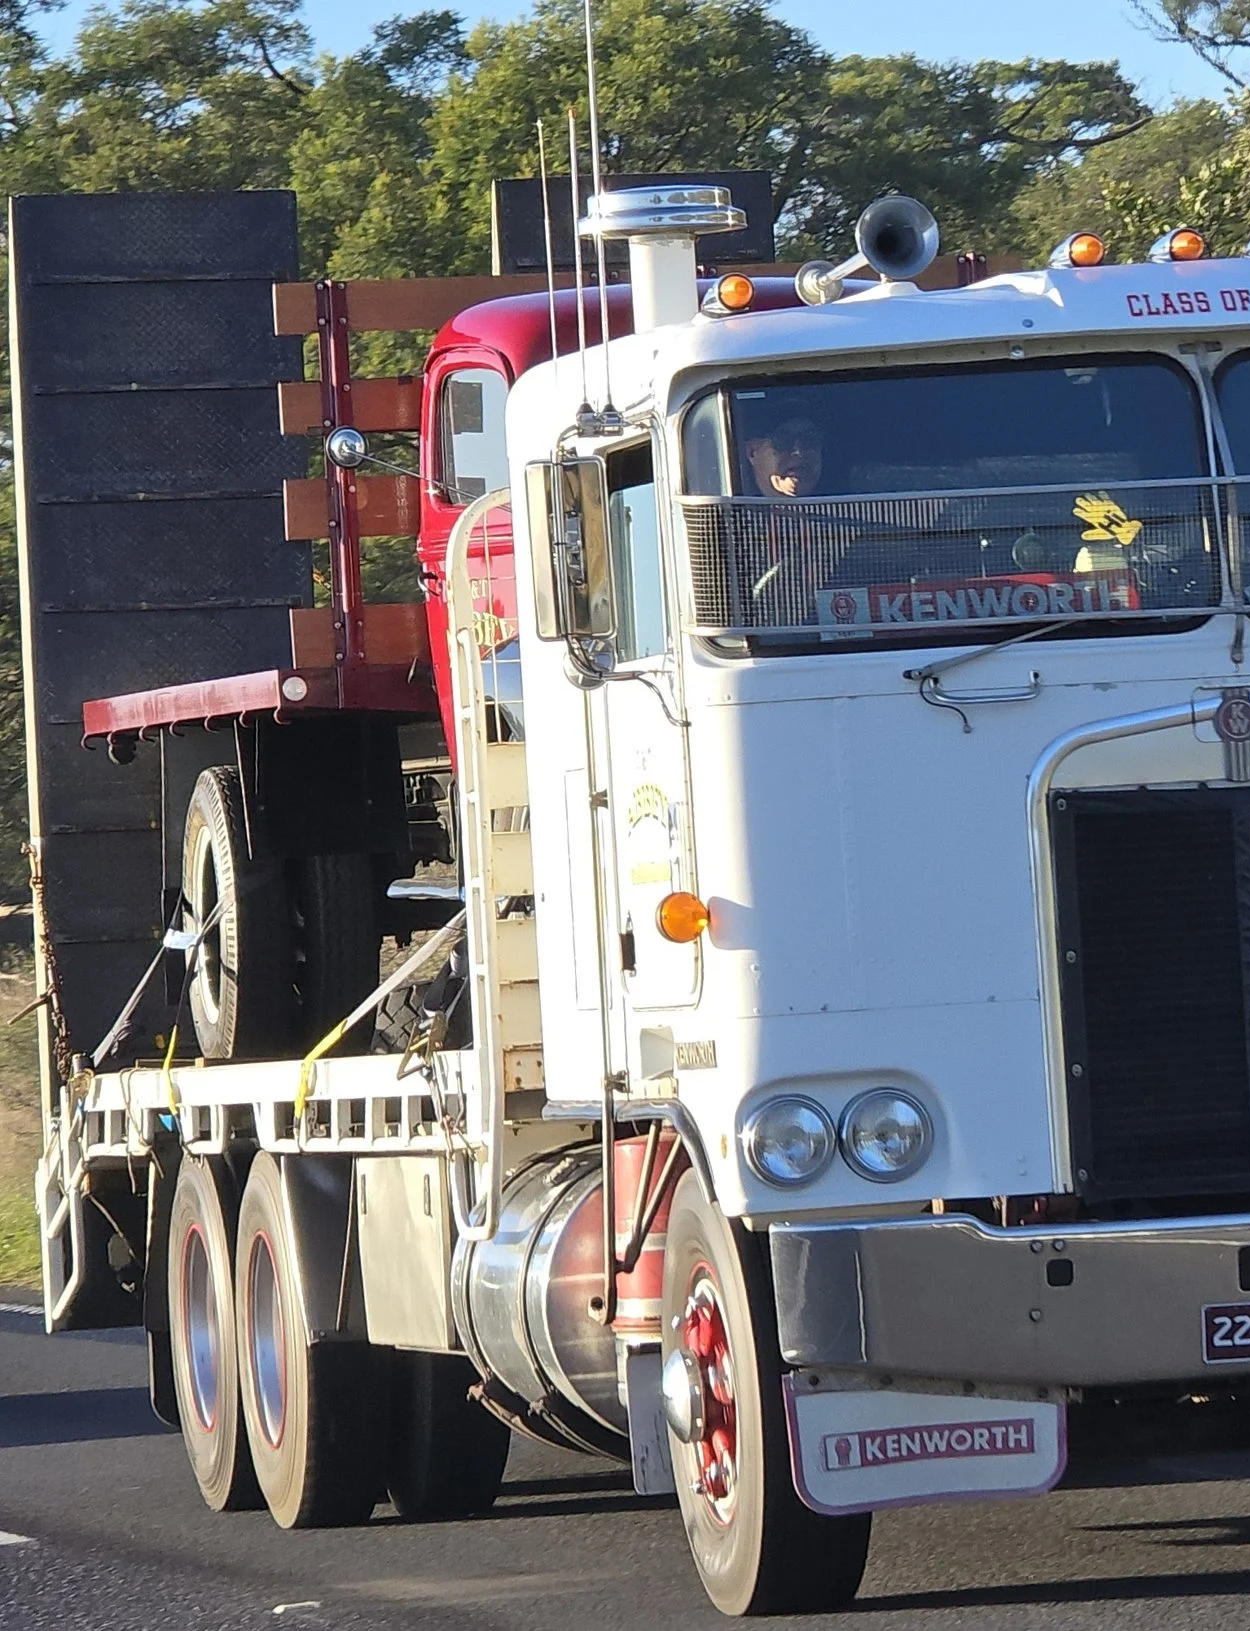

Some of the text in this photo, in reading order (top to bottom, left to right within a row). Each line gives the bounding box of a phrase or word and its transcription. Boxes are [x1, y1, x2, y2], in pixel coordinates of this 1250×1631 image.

[1126, 291, 1211, 317] CLASS
[879, 579, 1129, 623] KENWORTH
[865, 1424, 1028, 1461] KENWORTH
